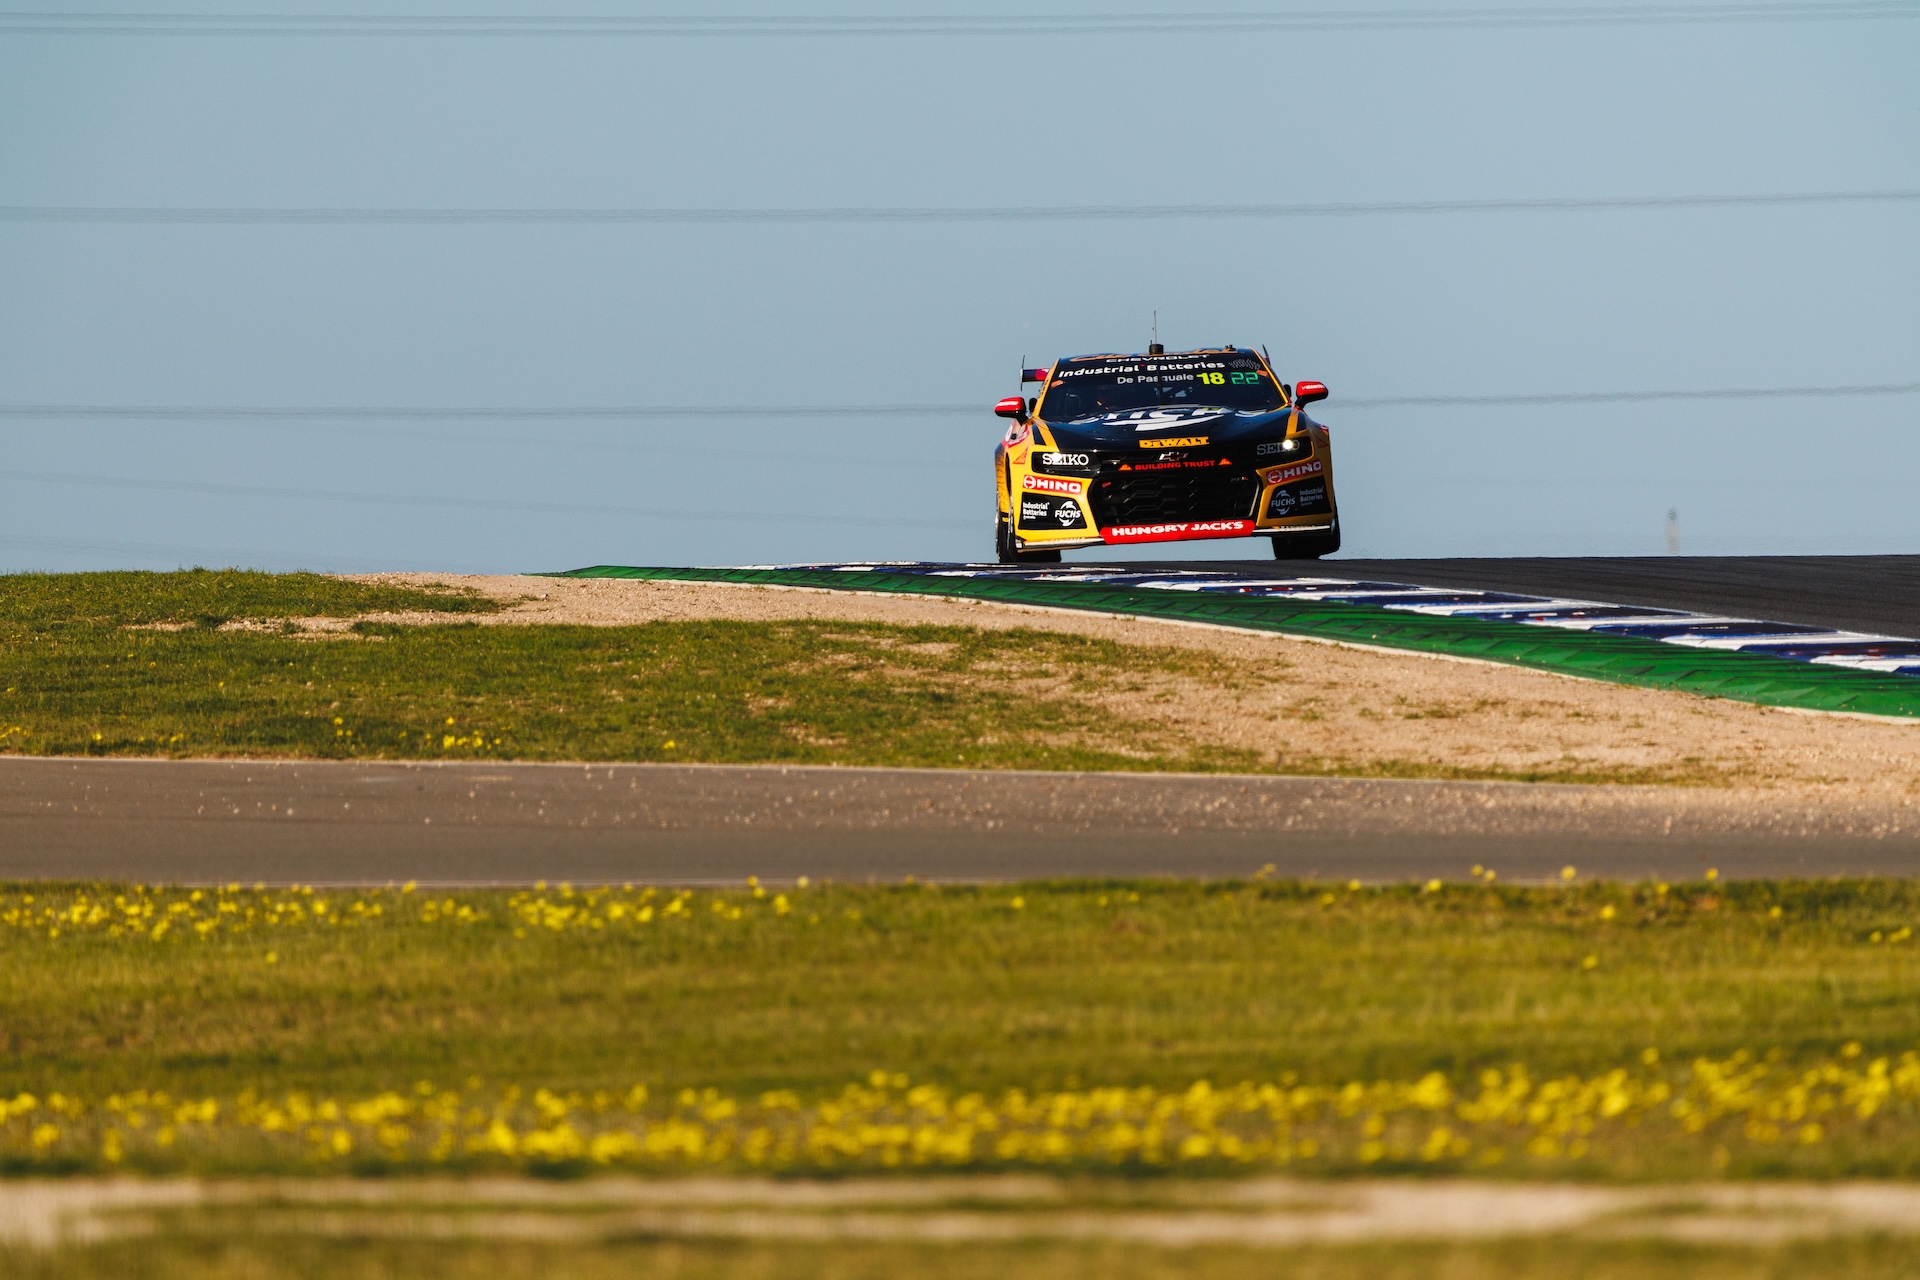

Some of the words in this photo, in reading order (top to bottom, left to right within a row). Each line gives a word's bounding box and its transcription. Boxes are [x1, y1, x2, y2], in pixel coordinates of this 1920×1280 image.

[1059, 365, 1139, 378] Industrial
[1146, 361, 1225, 371] Batteries
[1117, 376, 1134, 385] De
[1196, 372, 1225, 385] 18
[1230, 371, 1260, 385] 22
[1134, 462, 1182, 470] BUILDING
[1184, 460, 1216, 468] TRUST
[1284, 461, 1322, 478] HINO
[1036, 479, 1082, 493] HINO
[1271, 497, 1296, 507] FUCHS
[1054, 509, 1082, 519] FUCHS
[1112, 525, 1188, 536] HUNGRY
